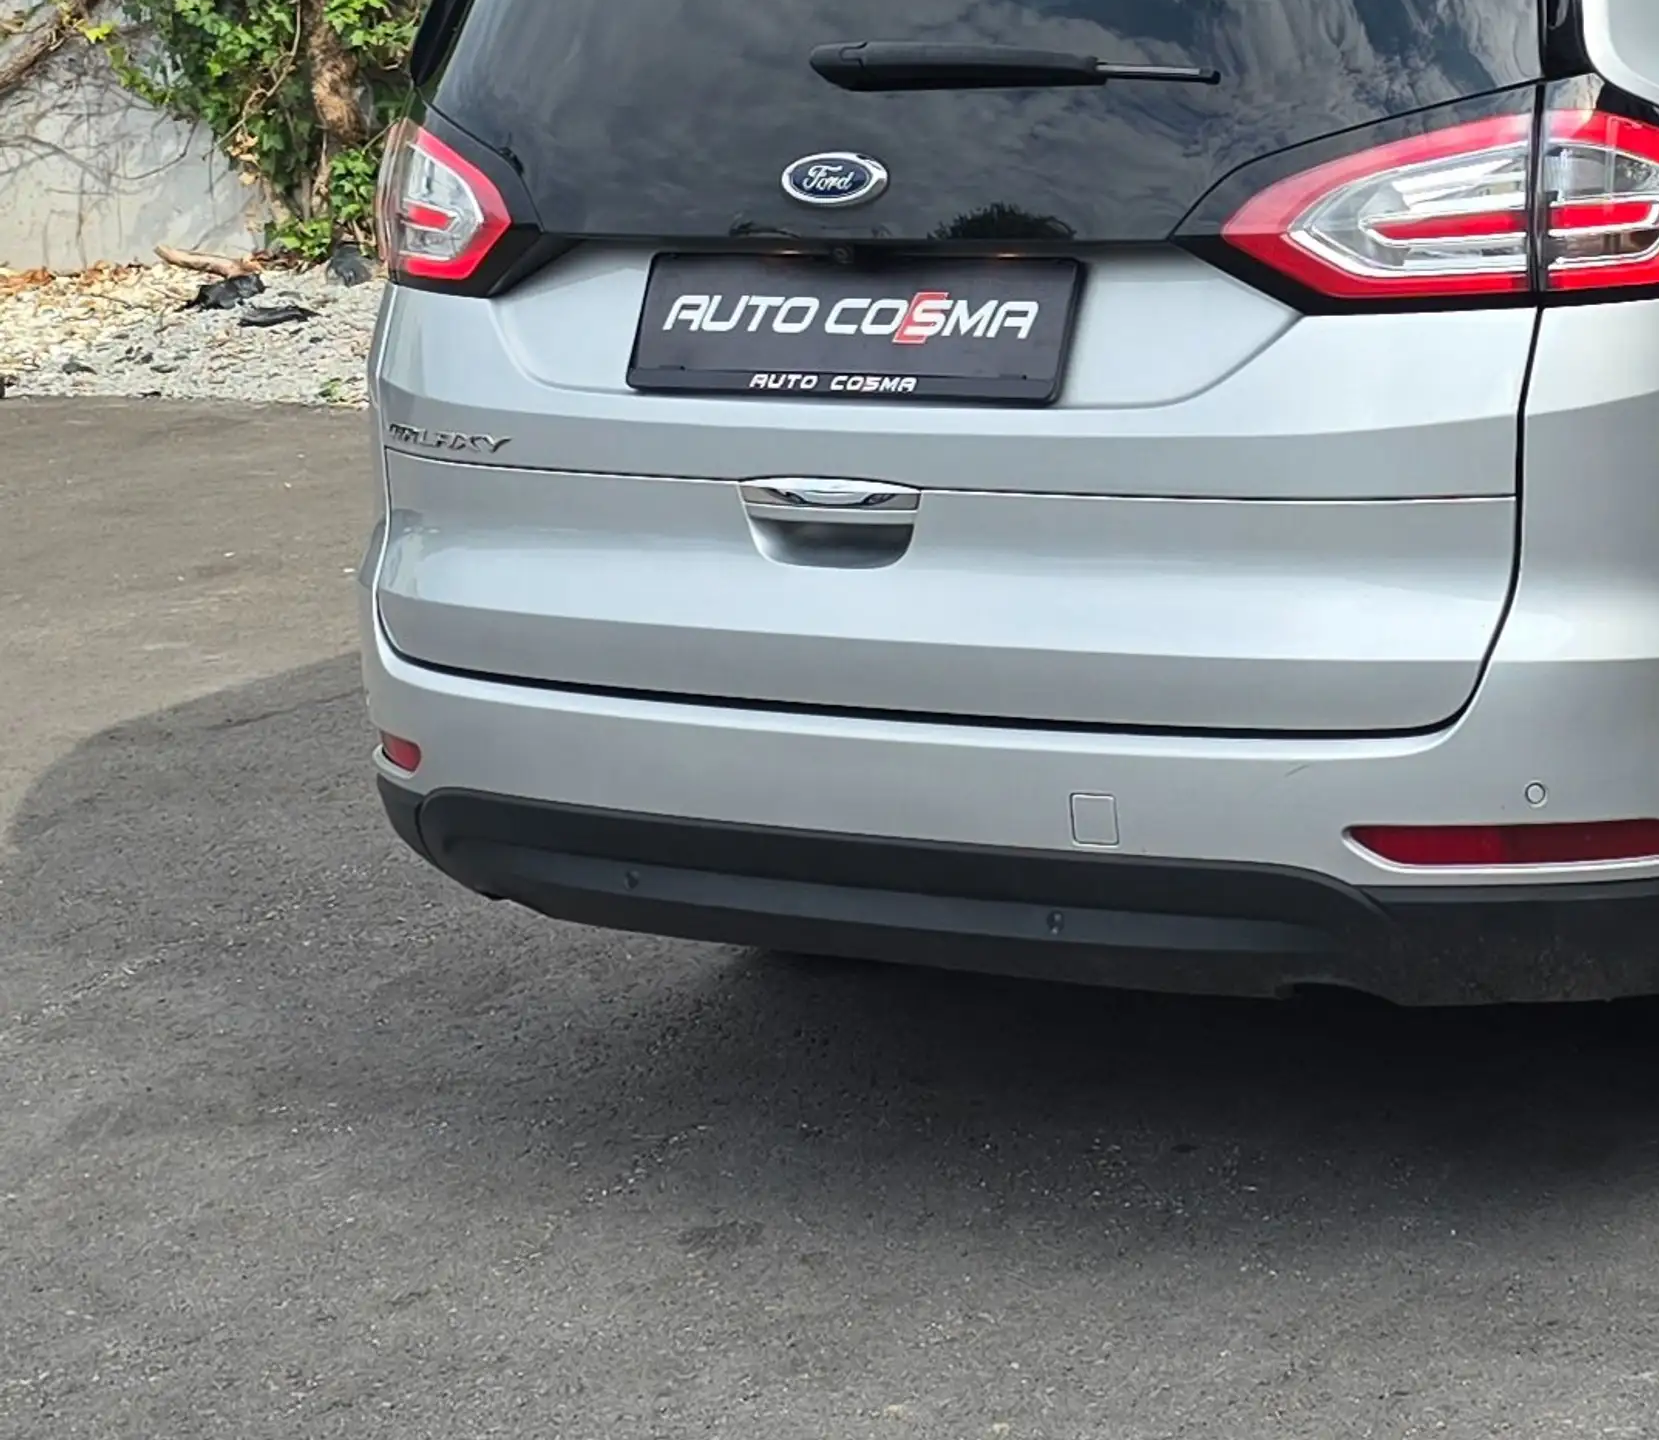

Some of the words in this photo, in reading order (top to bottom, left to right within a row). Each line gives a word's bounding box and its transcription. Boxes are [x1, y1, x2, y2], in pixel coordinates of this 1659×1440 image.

[802, 165, 855, 191] Ford
[662, 295, 820, 333] AUTO
[825, 297, 1040, 340] COSMA
[749, 373, 819, 390] AUTO
[830, 375, 918, 394] COSMA
